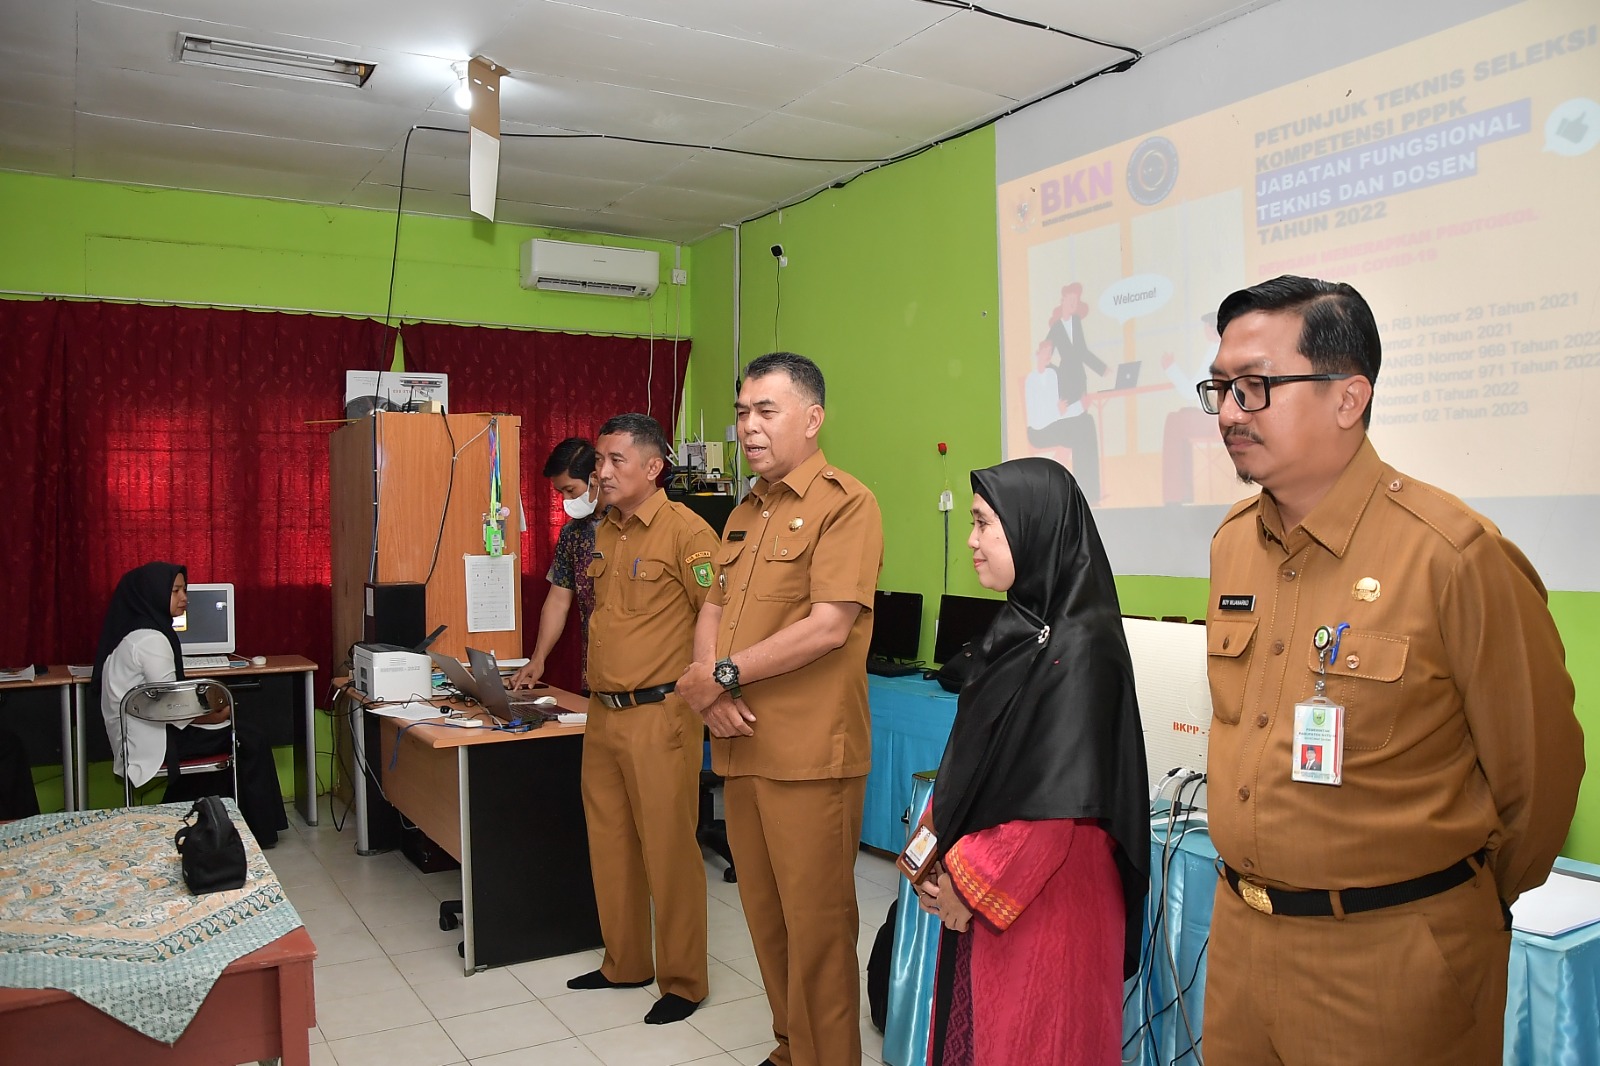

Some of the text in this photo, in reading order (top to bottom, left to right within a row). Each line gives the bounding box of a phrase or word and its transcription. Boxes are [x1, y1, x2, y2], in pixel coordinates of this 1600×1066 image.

[1255, 24, 1597, 149] PETUNJUK TEKNIS SELEKSI
[1255, 96, 1468, 172] KOMPETENSI PPPK
[1256, 112, 1521, 197] JABATAN FUNGSIONAL
[1040, 160, 1114, 217] BKN
[1257, 151, 1475, 221] TEKNIS DAN DOSEN
[1257, 200, 1387, 245] TAHUN 2022
[1113, 287, 1157, 306] Welcome!
[1391, 316, 1413, 332] RB
[1416, 312, 1462, 329] Nomor
[1465, 306, 1485, 321] 29
[1488, 301, 1536, 318] Tahun
[1539, 291, 1579, 310] 2021
[1416, 334, 1426, 348] 2
[1429, 328, 1473, 345] Tahun
[1477, 321, 1512, 340] 2021
[1428, 349, 1475, 365] Nomor
[1511, 338, 1559, 355] Tahun
[1428, 368, 1475, 384] Nomor
[1478, 362, 1505, 379] 971
[1511, 358, 1559, 376] Tahun
[1375, 380, 1520, 408] Nomor 8 Tahun 2022
[1375, 400, 1529, 426] Nomor 02 Tahun 2023
[1173, 721, 1200, 735] BKPP
